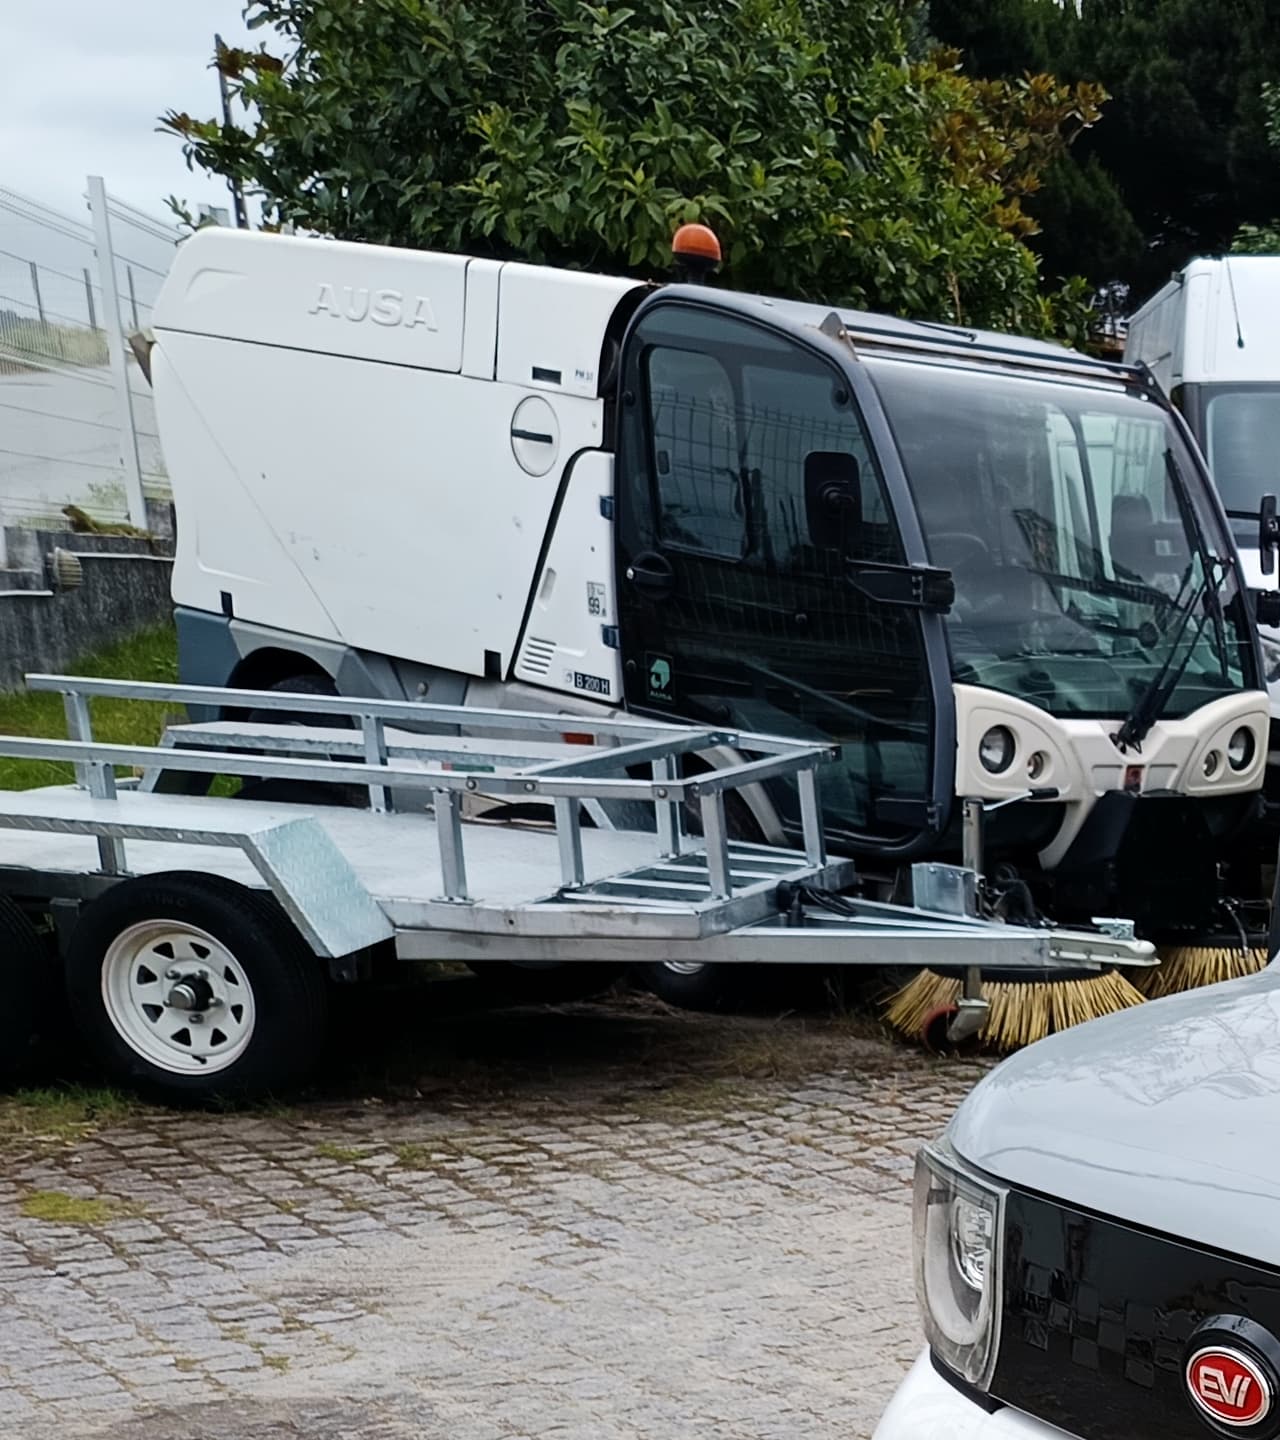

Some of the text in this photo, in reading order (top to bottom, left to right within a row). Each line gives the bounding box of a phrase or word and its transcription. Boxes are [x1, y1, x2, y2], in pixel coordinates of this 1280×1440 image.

[307, 283, 439, 333] AUSA
[576, 674, 584, 689] B
[601, 679, 609, 695] H
[1198, 1365, 1252, 1409] EVI
